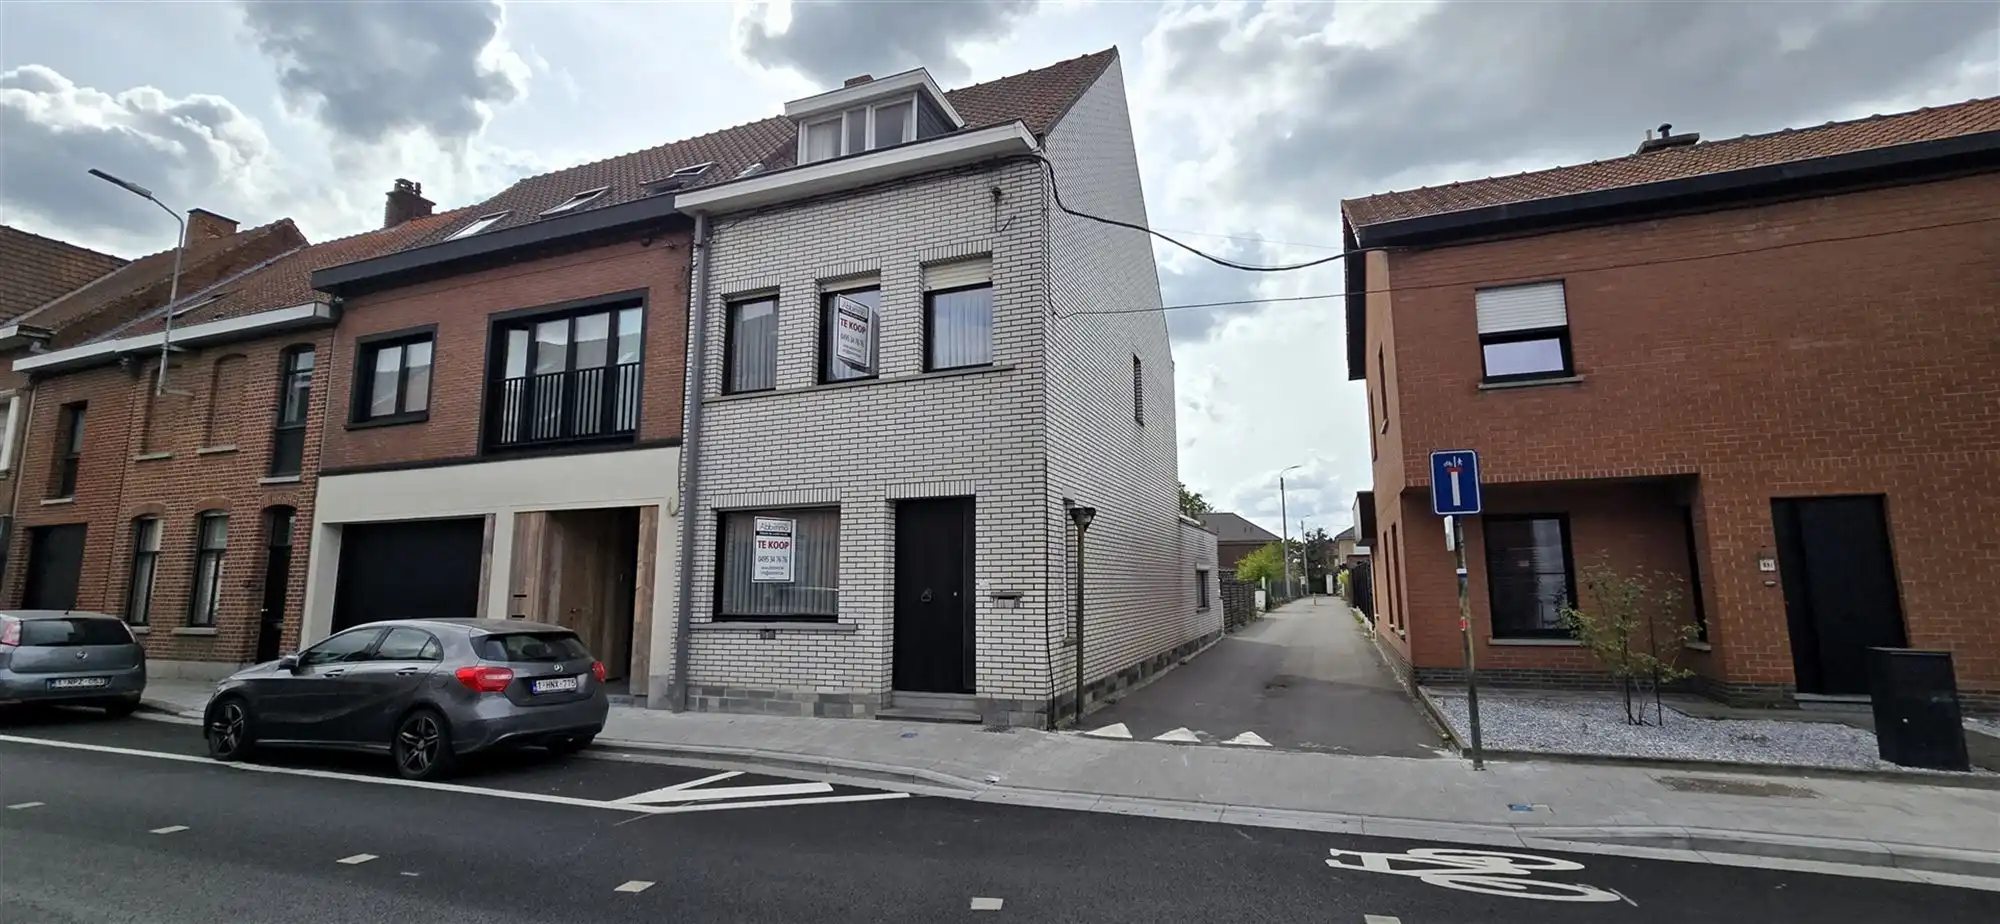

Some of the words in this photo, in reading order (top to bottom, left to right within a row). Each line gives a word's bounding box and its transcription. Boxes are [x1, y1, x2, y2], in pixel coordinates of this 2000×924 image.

[840, 318, 849, 328] TE
[849, 321, 867, 334] KOOP
[758, 541, 767, 549] TE
[768, 541, 790, 549] KOOP
